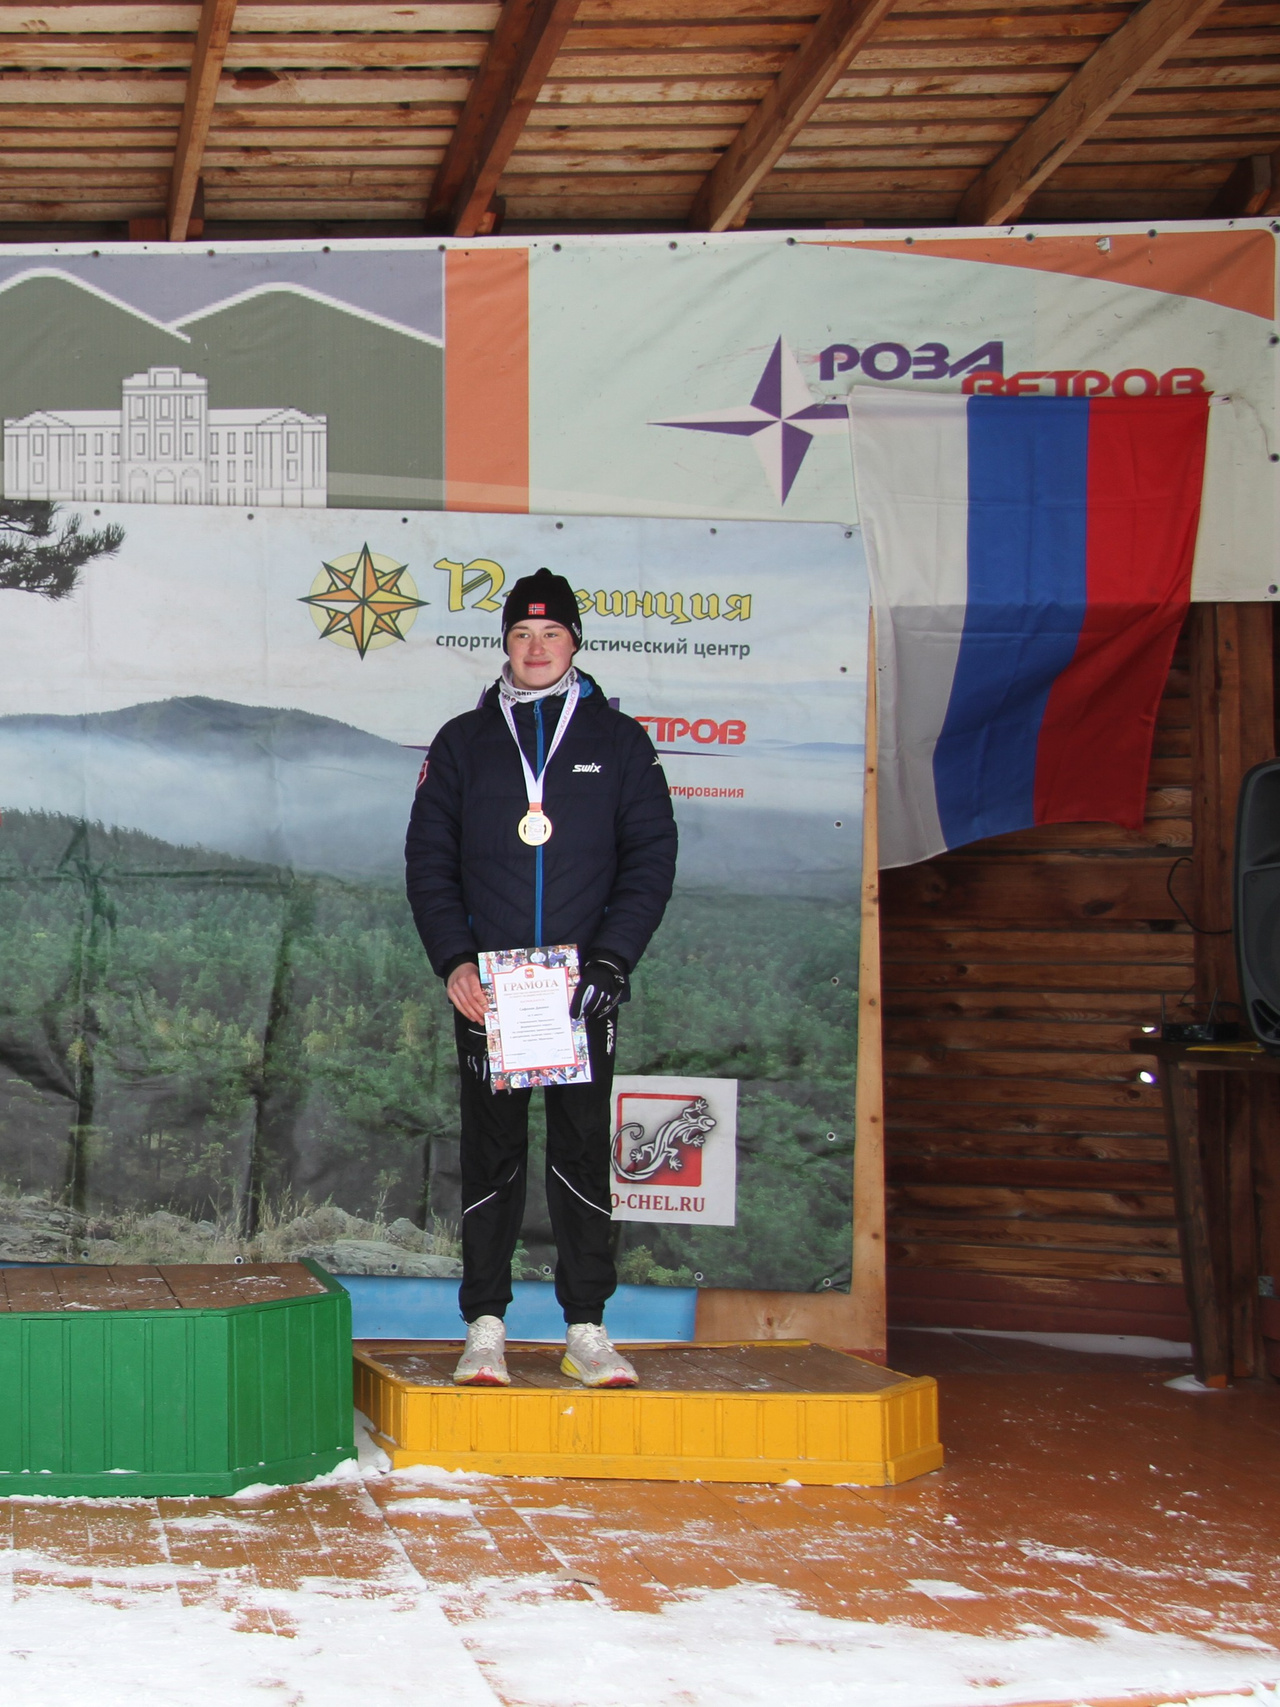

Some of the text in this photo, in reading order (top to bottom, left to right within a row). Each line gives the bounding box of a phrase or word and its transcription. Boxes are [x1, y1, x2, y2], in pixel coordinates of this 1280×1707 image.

[819, 341, 1004, 381] РОЗА
[433, 558, 752, 625] Пвинция
[436, 634, 751, 660] спортиистический центр
[634, 716, 747, 745] ТРОВ
[669, 786, 744, 799] тирования
[503, 978, 560, 992] ГРАМОТА
